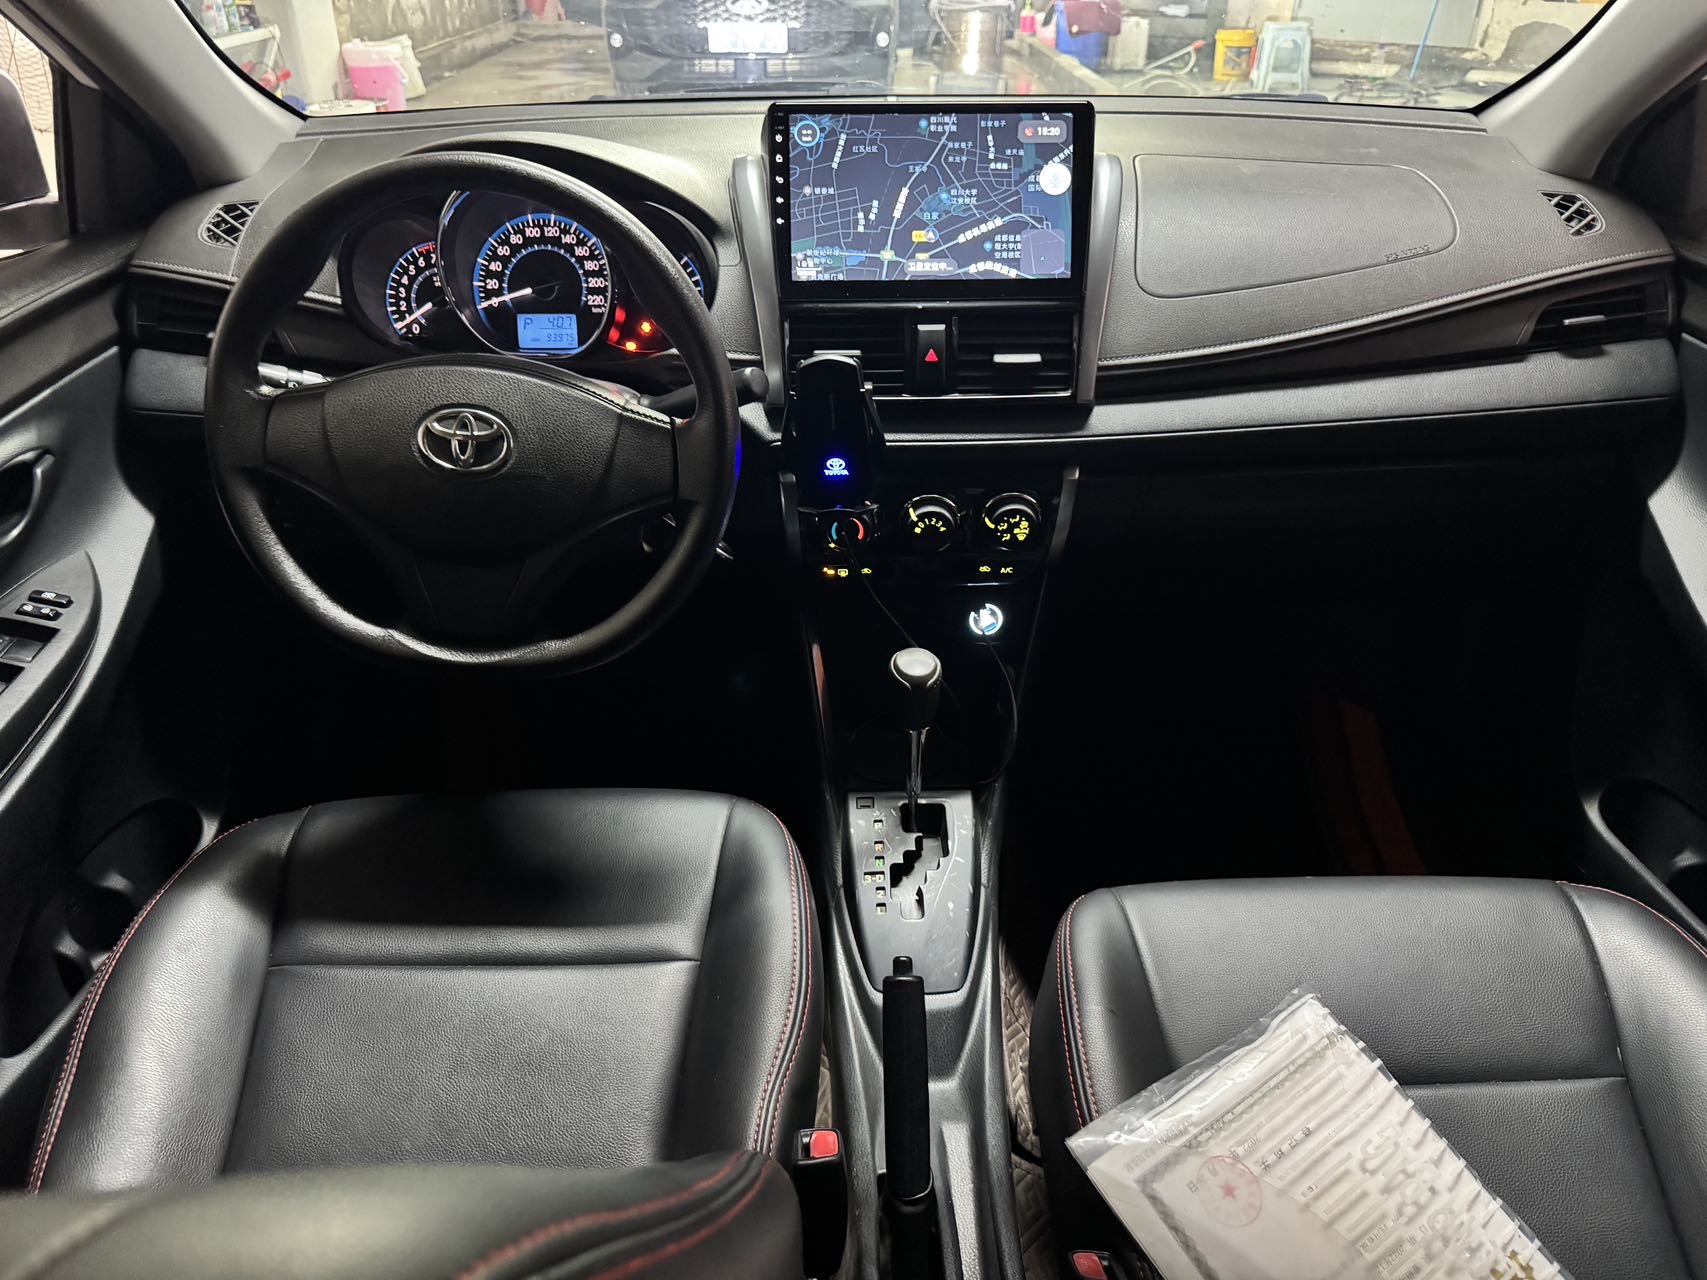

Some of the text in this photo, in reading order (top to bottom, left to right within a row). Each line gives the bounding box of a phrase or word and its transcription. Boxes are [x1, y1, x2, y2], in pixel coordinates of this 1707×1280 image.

[525, 227, 540, 237] 100
[544, 227, 560, 237] 120
[510, 234, 523, 244] 80
[561, 234, 577, 244] 140
[497, 246, 510, 256] 60
[574, 246, 590, 256] 160
[418, 256, 425, 267] 6
[430, 254, 436, 264] 7
[408, 264, 416, 275] 5
[488, 262, 502, 271] 40
[584, 260, 600, 270] 180
[401, 275, 409, 285] 4
[486, 279, 499, 289] 20
[588, 277, 605, 287] 200
[398, 287, 406, 298] 3
[587, 295, 605, 305] 220
[399, 301, 407, 311] 2
[523, 316, 573, 330] P 407
[412, 323, 420, 334] 0
[930, 517, 937, 525] 2
[1000, 566, 1013, 574] A/C
[875, 843, 884, 852] R
[875, 858, 884, 867] N
[876, 890, 885, 898] 2
